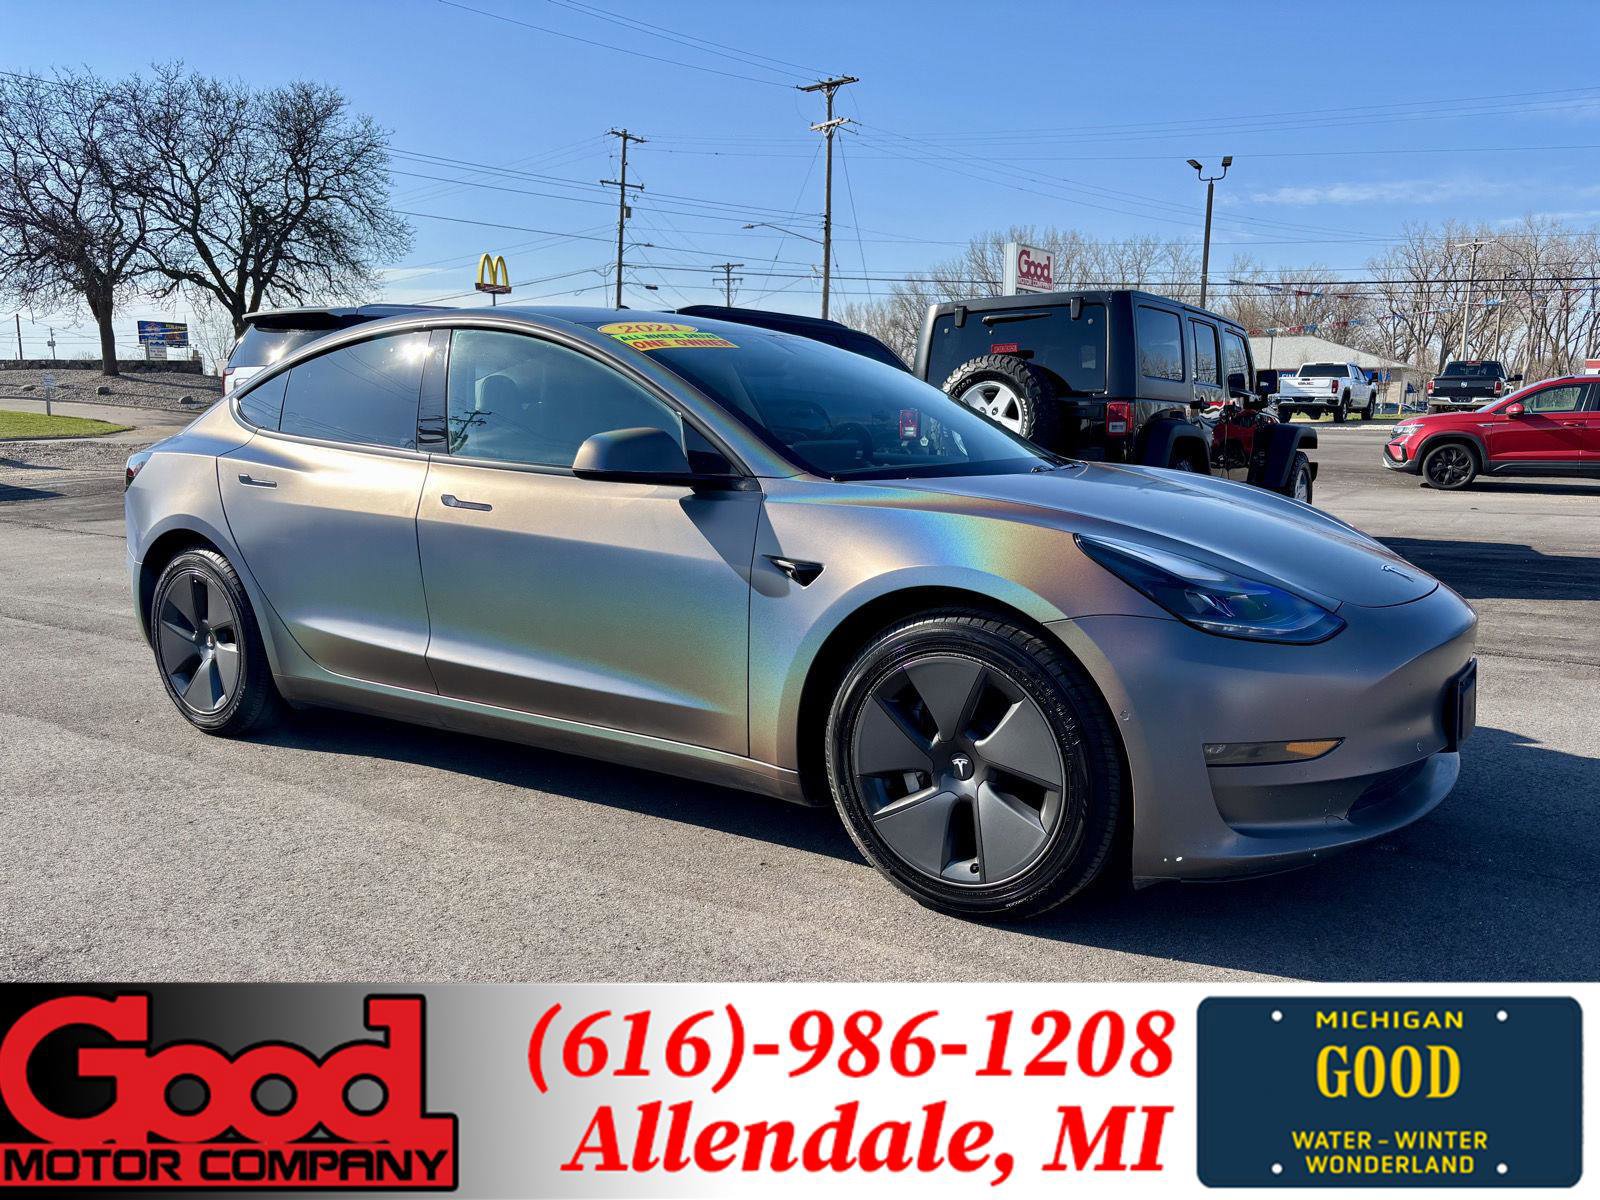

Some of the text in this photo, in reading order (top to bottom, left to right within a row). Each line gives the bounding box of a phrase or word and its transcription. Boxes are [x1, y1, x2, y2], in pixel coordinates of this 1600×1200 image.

[1018, 249, 1052, 283] Good
[618, 324, 681, 334] 2021
[632, 339, 736, 348] ONE OWNER
